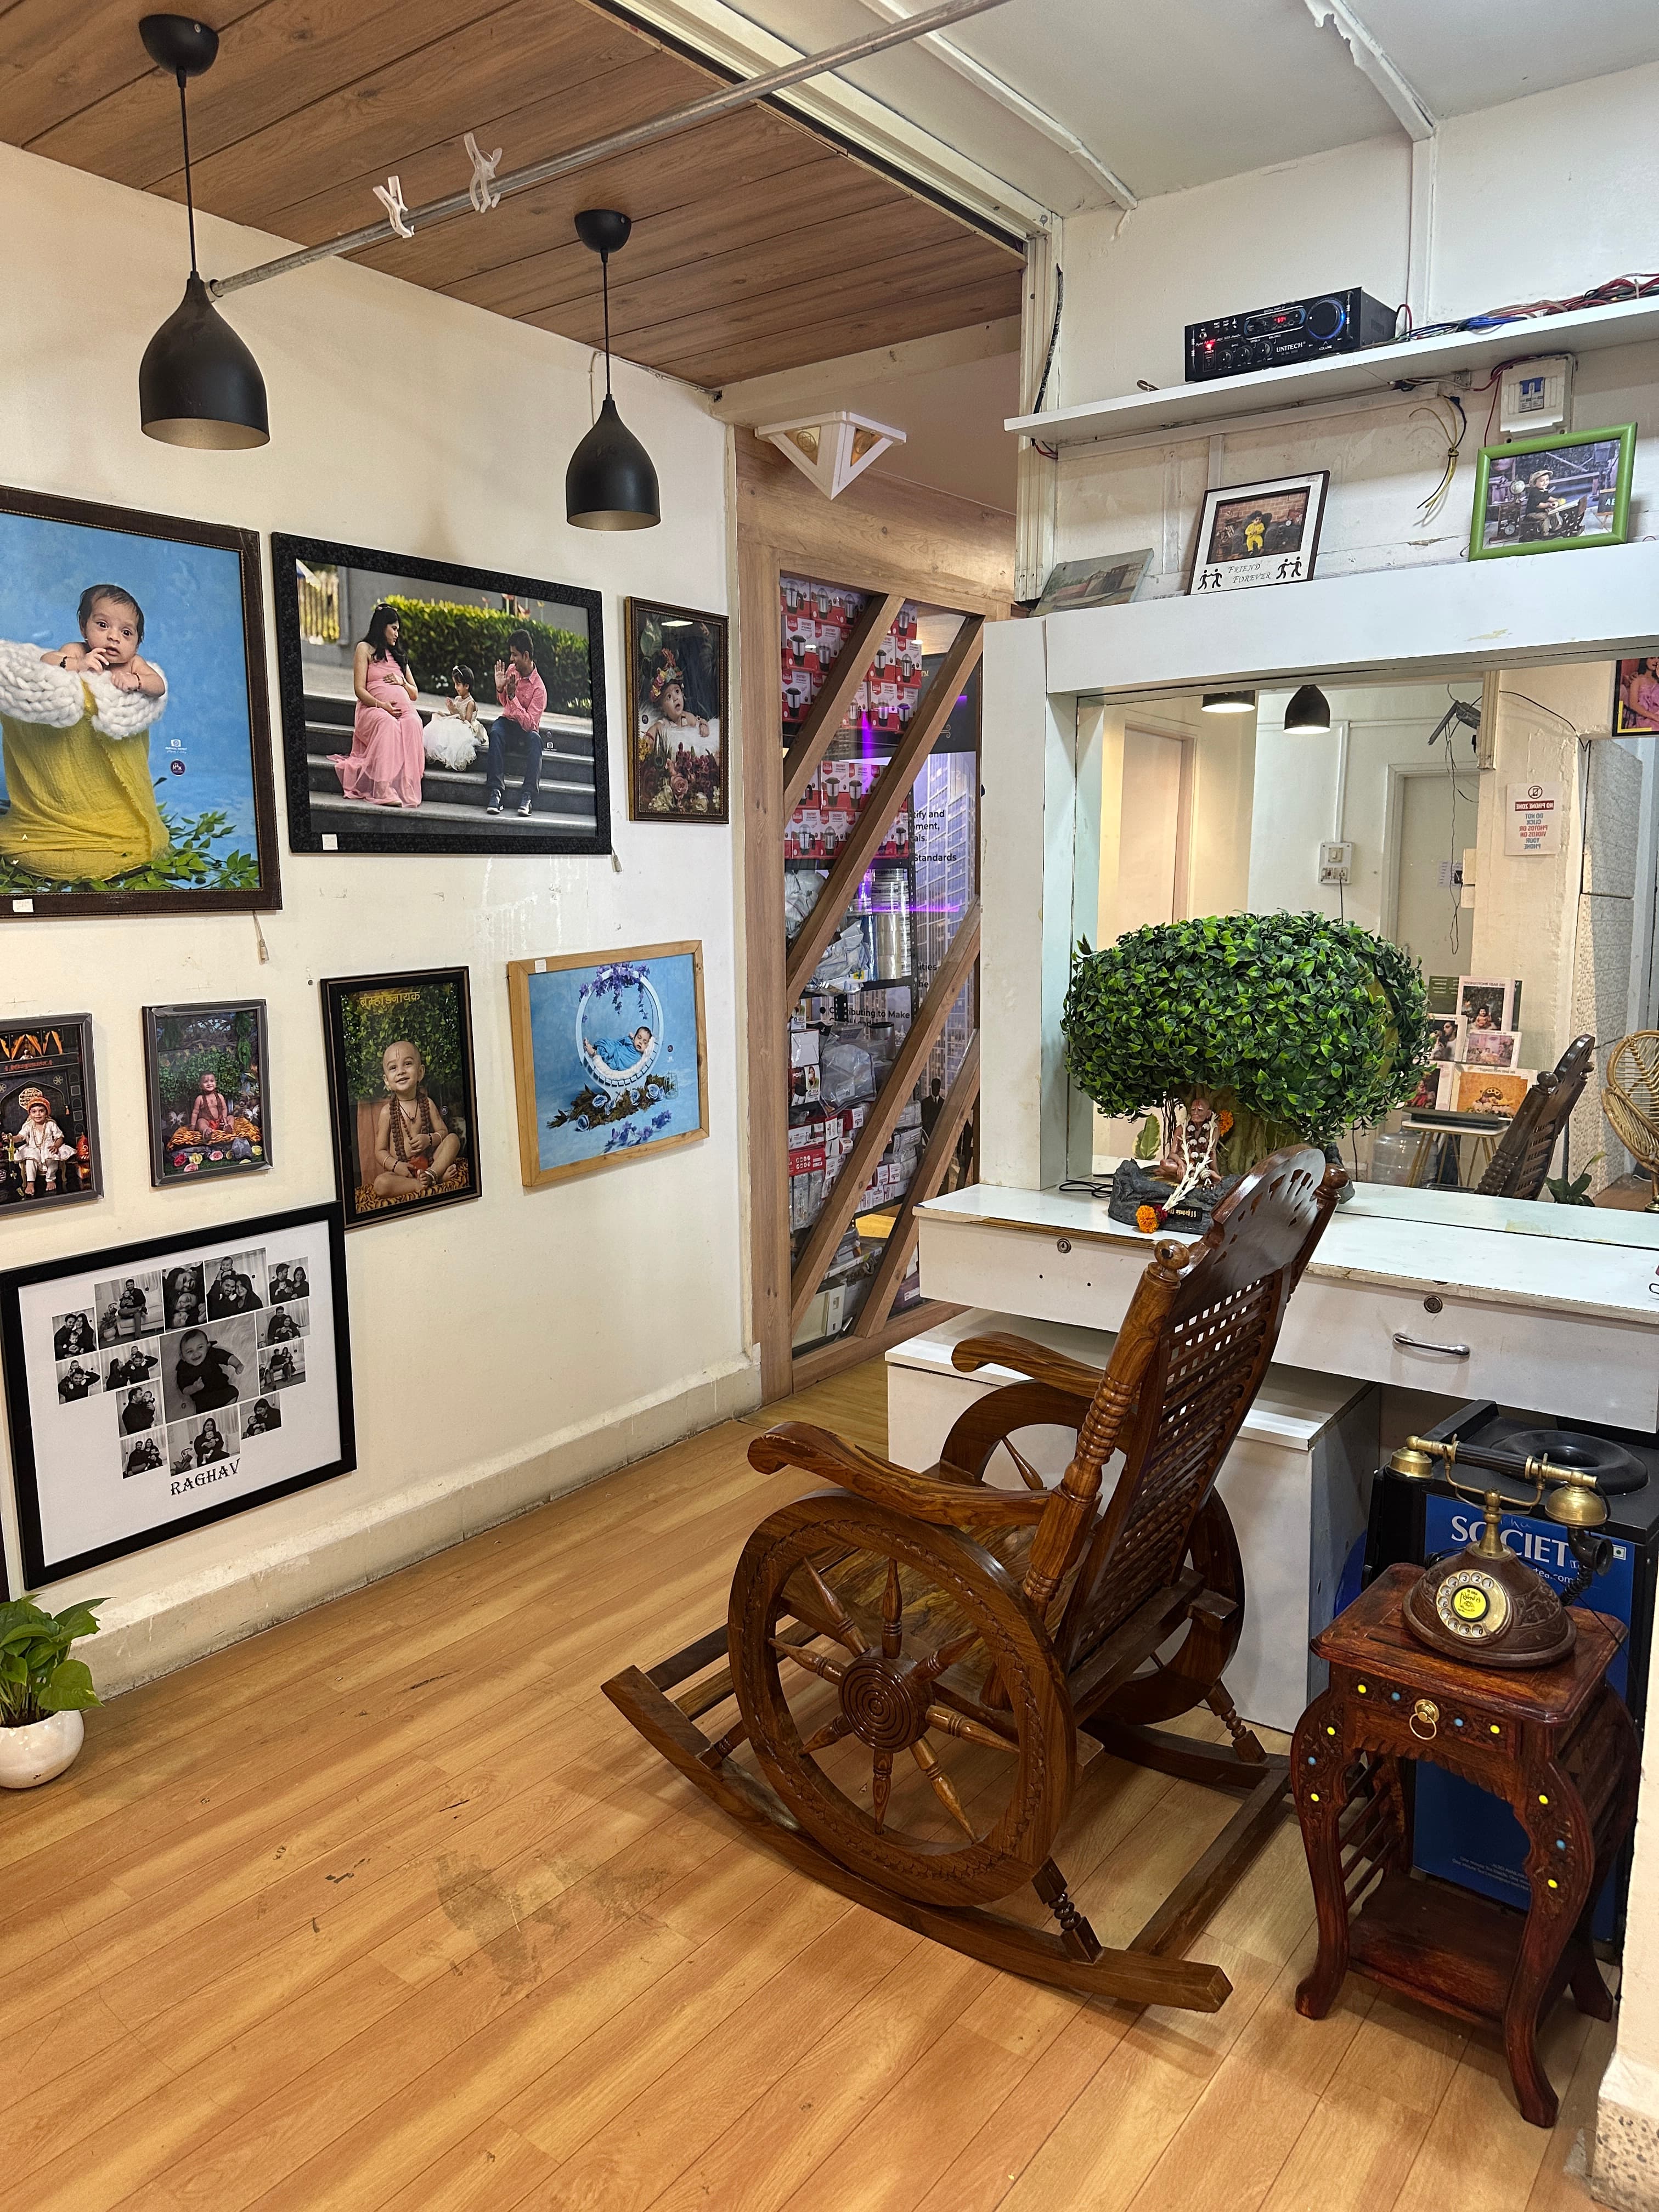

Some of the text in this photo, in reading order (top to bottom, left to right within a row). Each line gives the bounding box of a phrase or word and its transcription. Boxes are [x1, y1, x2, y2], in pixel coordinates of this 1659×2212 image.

[1228, 563, 1261, 574] FRIEND
[1233, 572, 1271, 583] FOREVER
[929, 810, 945, 818] and
[915, 822, 940, 831] ment,
[915, 854, 957, 862] Standards
[918, 962, 937, 970] ities
[171, 1458, 240, 1496] RAGHAV
